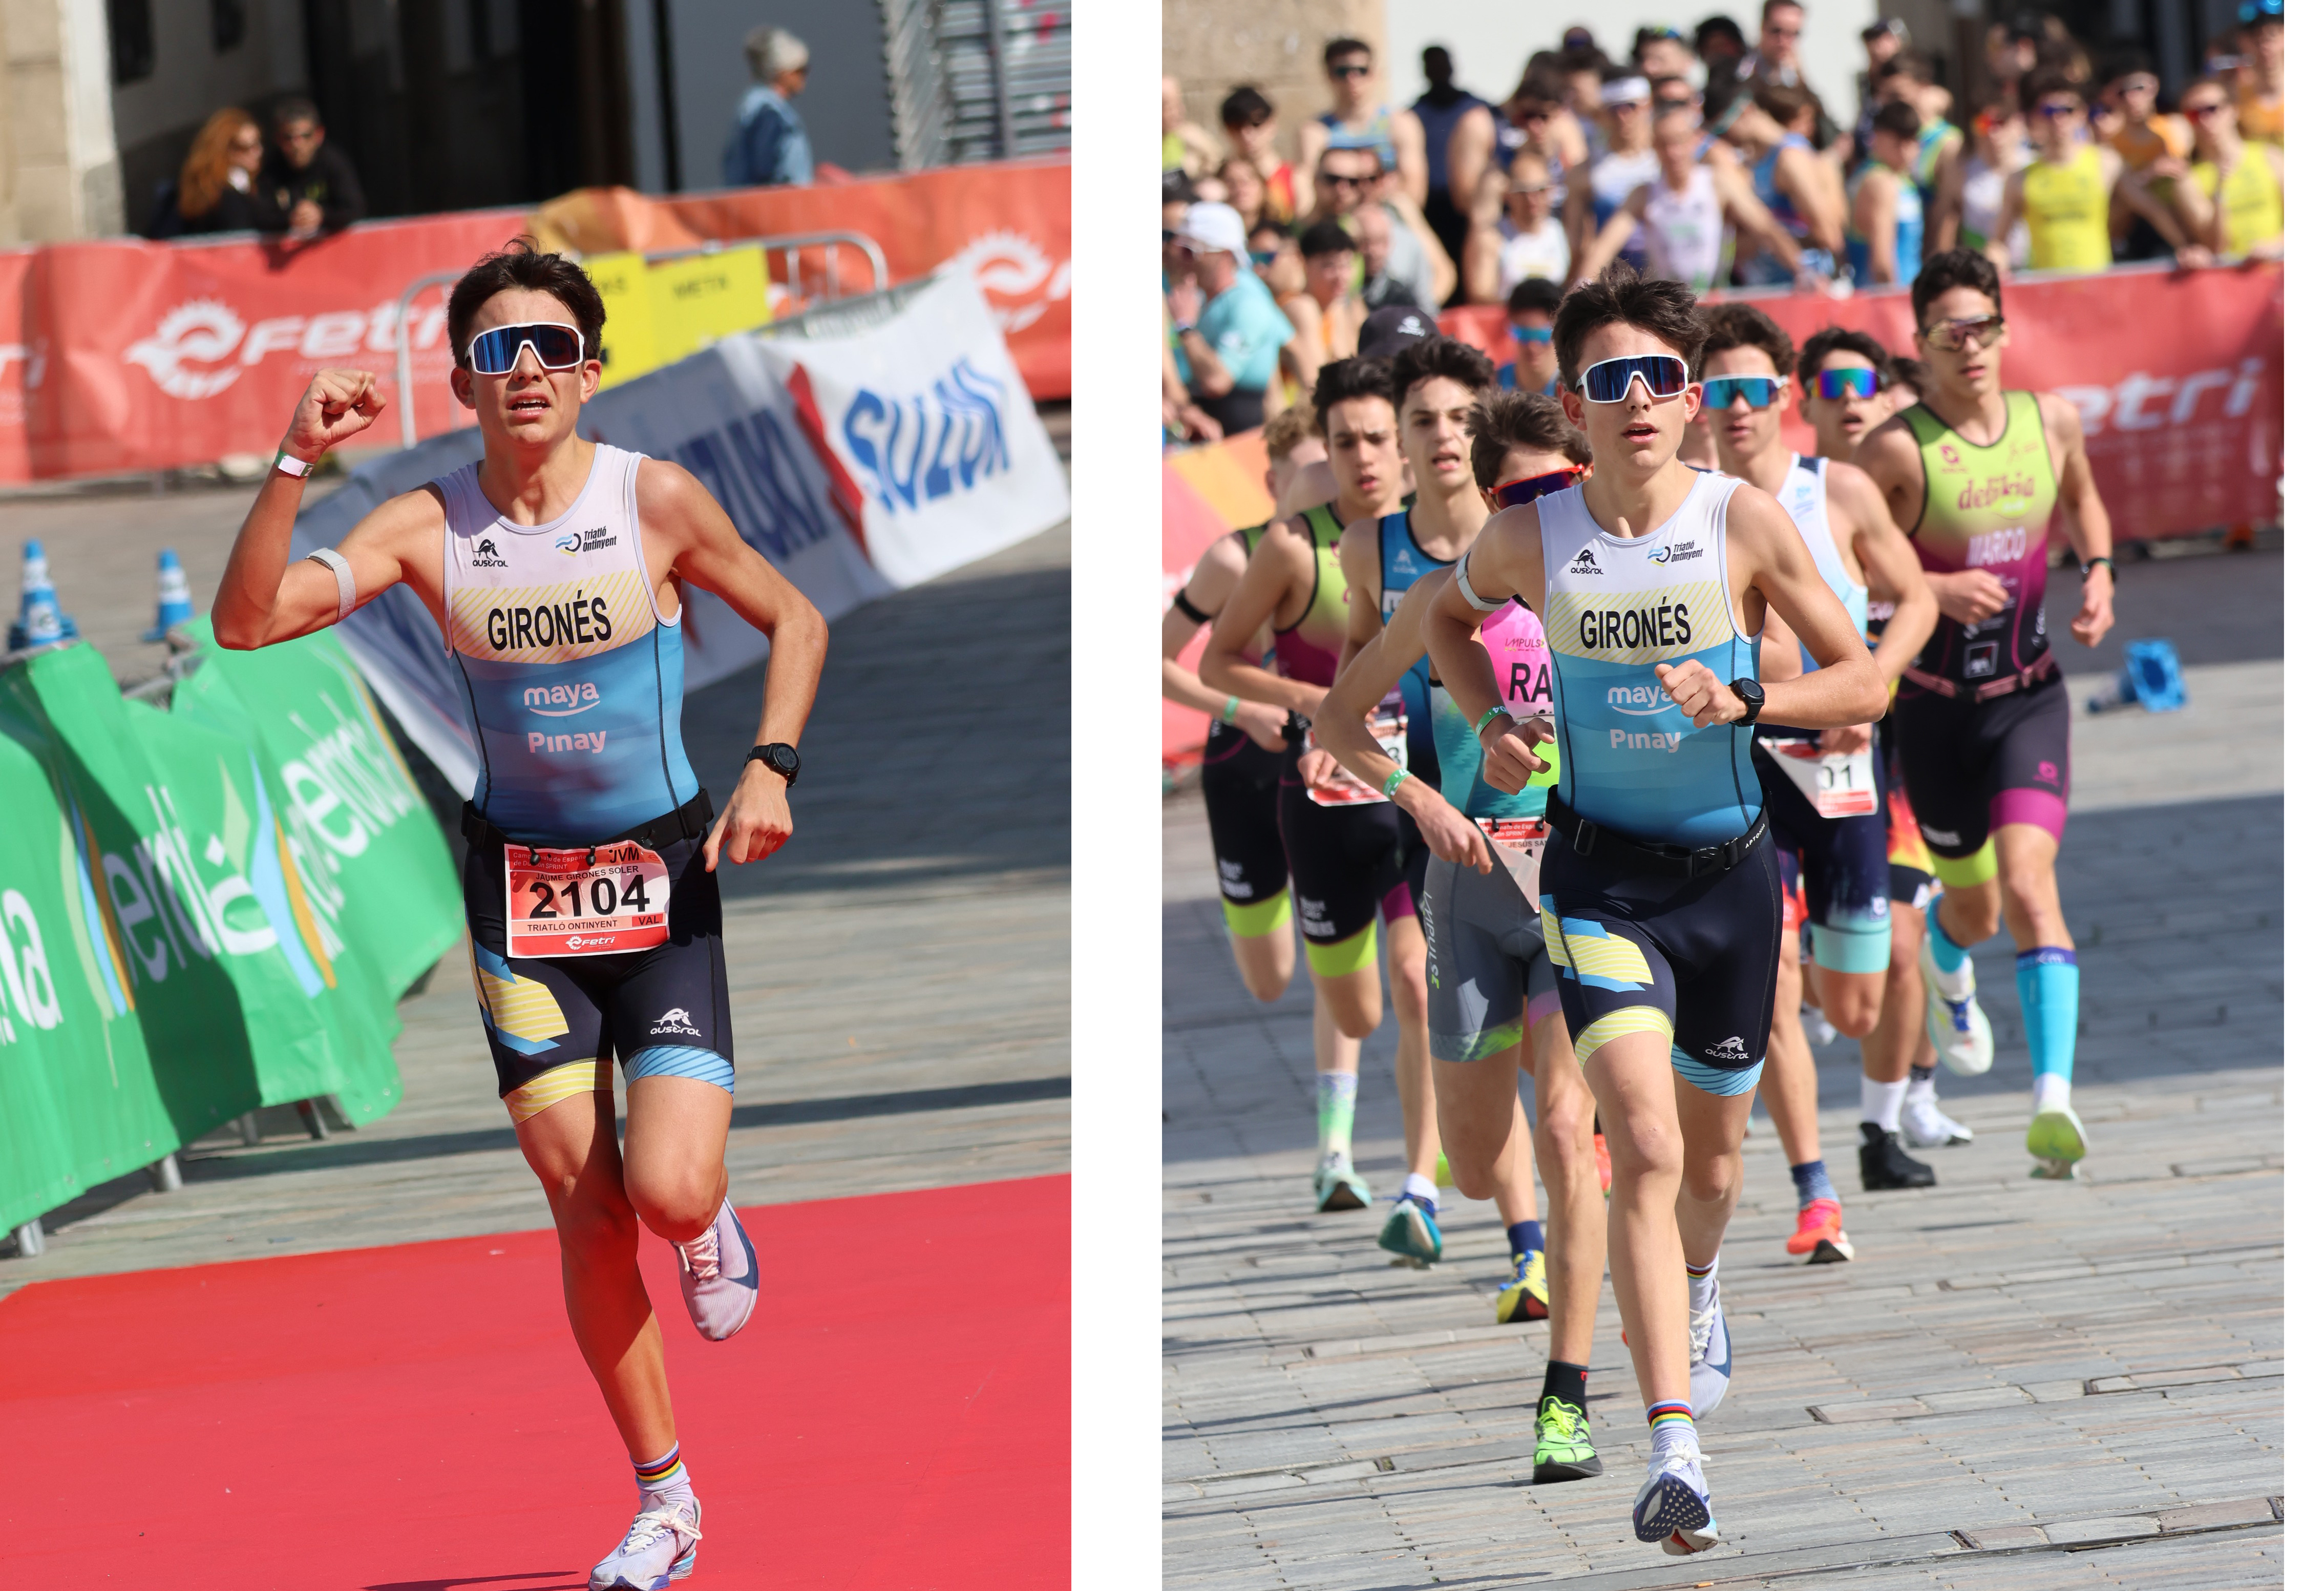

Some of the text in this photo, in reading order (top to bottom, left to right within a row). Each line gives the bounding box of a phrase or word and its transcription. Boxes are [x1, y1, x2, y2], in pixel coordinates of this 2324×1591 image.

[583, 526, 607, 541] Triatló
[583, 535, 617, 552] Ontinyent
[1673, 539, 1695, 554] Triatló
[472, 559, 509, 568] austral
[1671, 548, 1704, 563] Ontinyent
[487, 590, 612, 652] GIRONÉS
[1580, 596, 1692, 650] GIRONÉS
[524, 682, 600, 708] maya
[609, 847, 640, 864] JVM
[536, 866, 639, 882] JAUME GIRONES SOLER
[530, 874, 650, 919] 2104
[527, 916, 660, 932] TRIATLÓ ONTINYENT VAL
[650, 1024, 702, 1037] austral
[1704, 1048, 1749, 1060] austral
